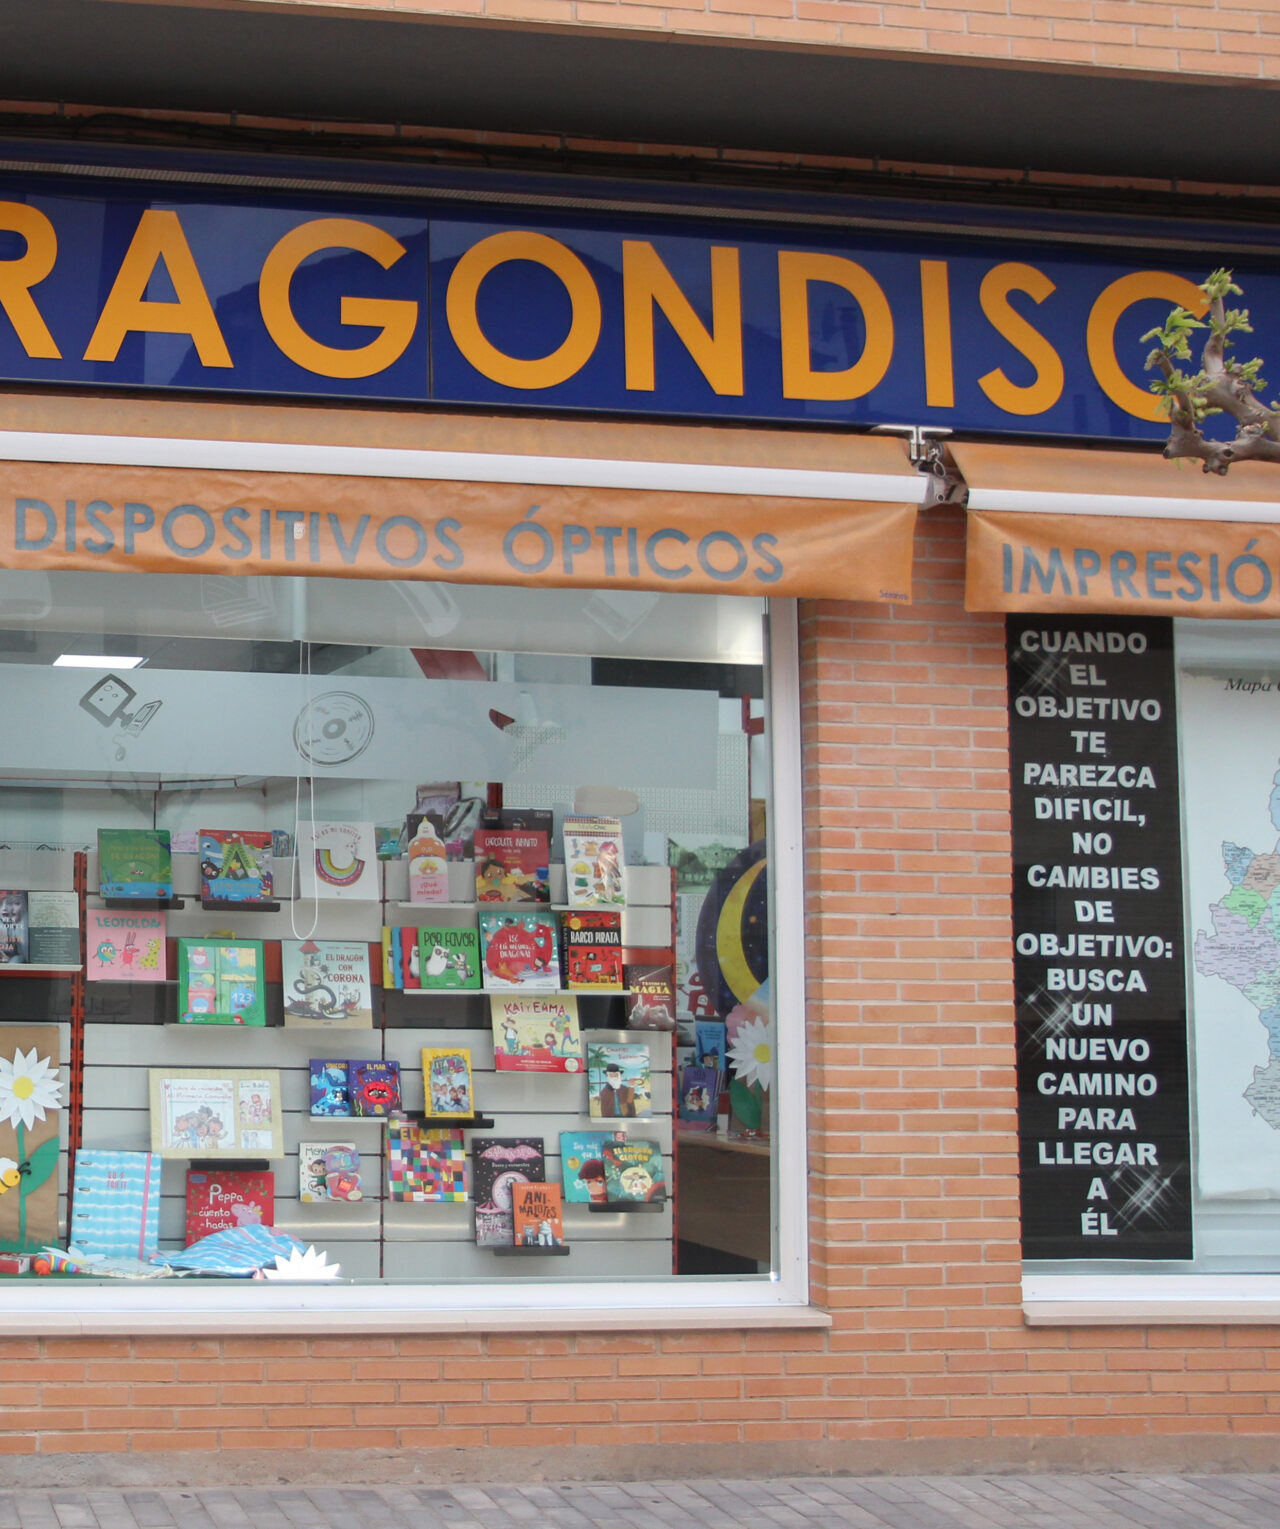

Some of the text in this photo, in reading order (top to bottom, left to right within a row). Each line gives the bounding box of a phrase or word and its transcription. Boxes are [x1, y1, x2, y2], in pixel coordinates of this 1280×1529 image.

[14, 497, 464, 570] DISPOSITIVOS
[502, 505, 784, 584] ÓPTICOS
[1001, 538, 1272, 604] IMPRESIÓ
[1020, 630, 1147, 654] CUANDO
[1071, 664, 1106, 686] EL
[1224, 678, 1272, 696] Mapa
[1015, 696, 1161, 721] OBJETIVO
[1071, 731, 1106, 753] TE
[1023, 763, 1156, 788] PAREZCA
[1034, 797, 1146, 827] DIFICIL,
[485, 838, 513, 846] CHOCOLATE
[1072, 832, 1112, 855] NO
[1027, 865, 1160, 890] CAMBIES
[96, 916, 162, 928] LEOTOLDA
[1075, 900, 1114, 923] DE
[424, 932, 476, 947] POR FAVOR
[570, 931, 619, 944] BARCO PIRATA
[1016, 934, 1173, 959] OBJETIVO:
[325, 953, 364, 961] EL DRAGÓN
[327, 974, 364, 983] CORONA
[629, 986, 671, 994] MAGIA
[1047, 968, 1147, 992] BUSCA
[1072, 1003, 1112, 1027] UN
[1045, 1037, 1150, 1062] NUEVO
[1037, 1072, 1158, 1097] CAMINO
[1058, 1107, 1137, 1131] PARA
[1038, 1142, 1158, 1166] LLEGAR
[209, 1184, 244, 1204] Peppa
[1086, 1177, 1109, 1200] A
[199, 1208, 230, 1217] cuento
[1081, 1207, 1119, 1236] ÉL
[206, 1219, 233, 1230] hadas
